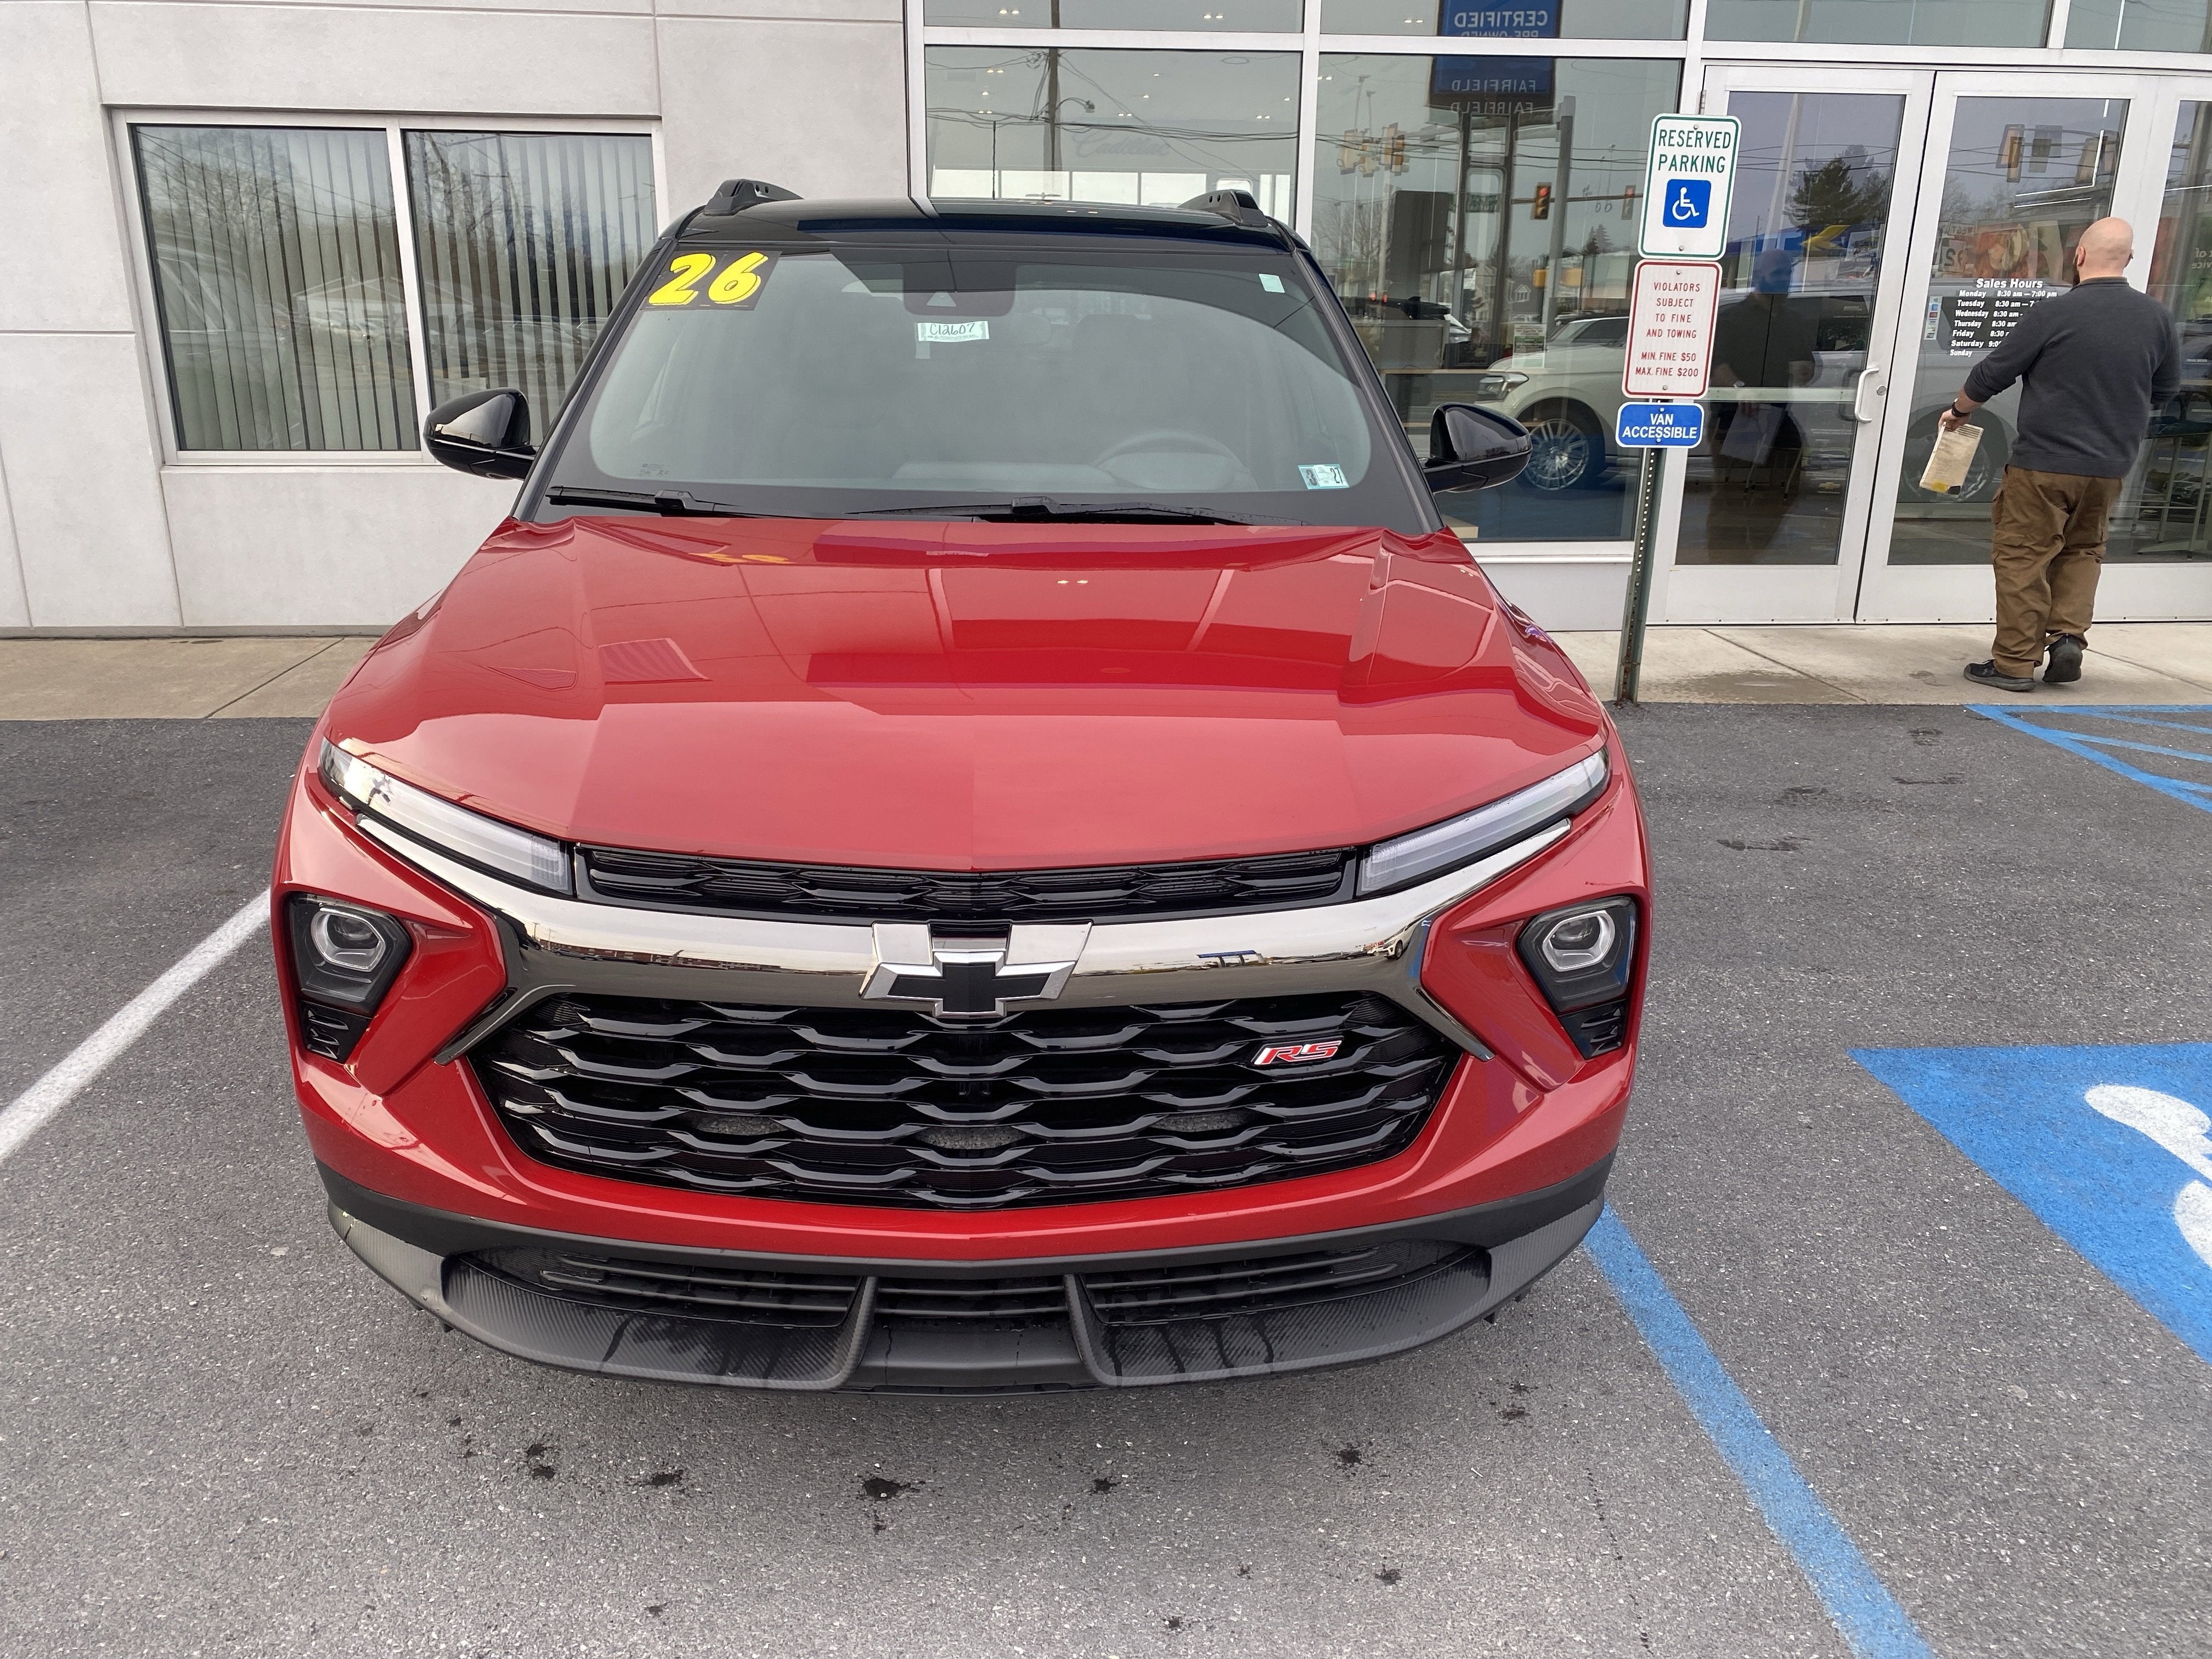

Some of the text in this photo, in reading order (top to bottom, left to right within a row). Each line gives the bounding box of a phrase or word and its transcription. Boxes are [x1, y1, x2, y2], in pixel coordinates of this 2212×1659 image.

[1658, 129, 1731, 149] RESERVED
[1658, 154, 1726, 173] PARKING
[648, 252, 768, 306] 26
[1976, 278, 2043, 289] Sales Hours
[1654, 282, 1700, 292] VIOLATORS
[1959, 290, 1987, 298] Monday
[1656, 298, 1694, 307] SUBJECT
[1957, 299, 1985, 308] Tuesday
[1655, 313, 1692, 323] TO FINE
[1955, 309, 1989, 318] Wednesday
[1954, 320, 1982, 329] Thursday
[1646, 329, 1697, 338] AND TOWING
[1952, 329, 1974, 338] Friday
[1951, 340, 1984, 348] Saturday
[1659, 352, 1677, 361] FINE
[1681, 352, 1696, 362] $50
[1950, 349, 1973, 358] Sunday
[1655, 367, 1673, 376] FINE
[1677, 368, 1699, 377] $200
[1650, 413, 1674, 425] VAN
[1622, 426, 1697, 439] ACCESSIBLE
[1254, 1040, 1342, 1065] RS
